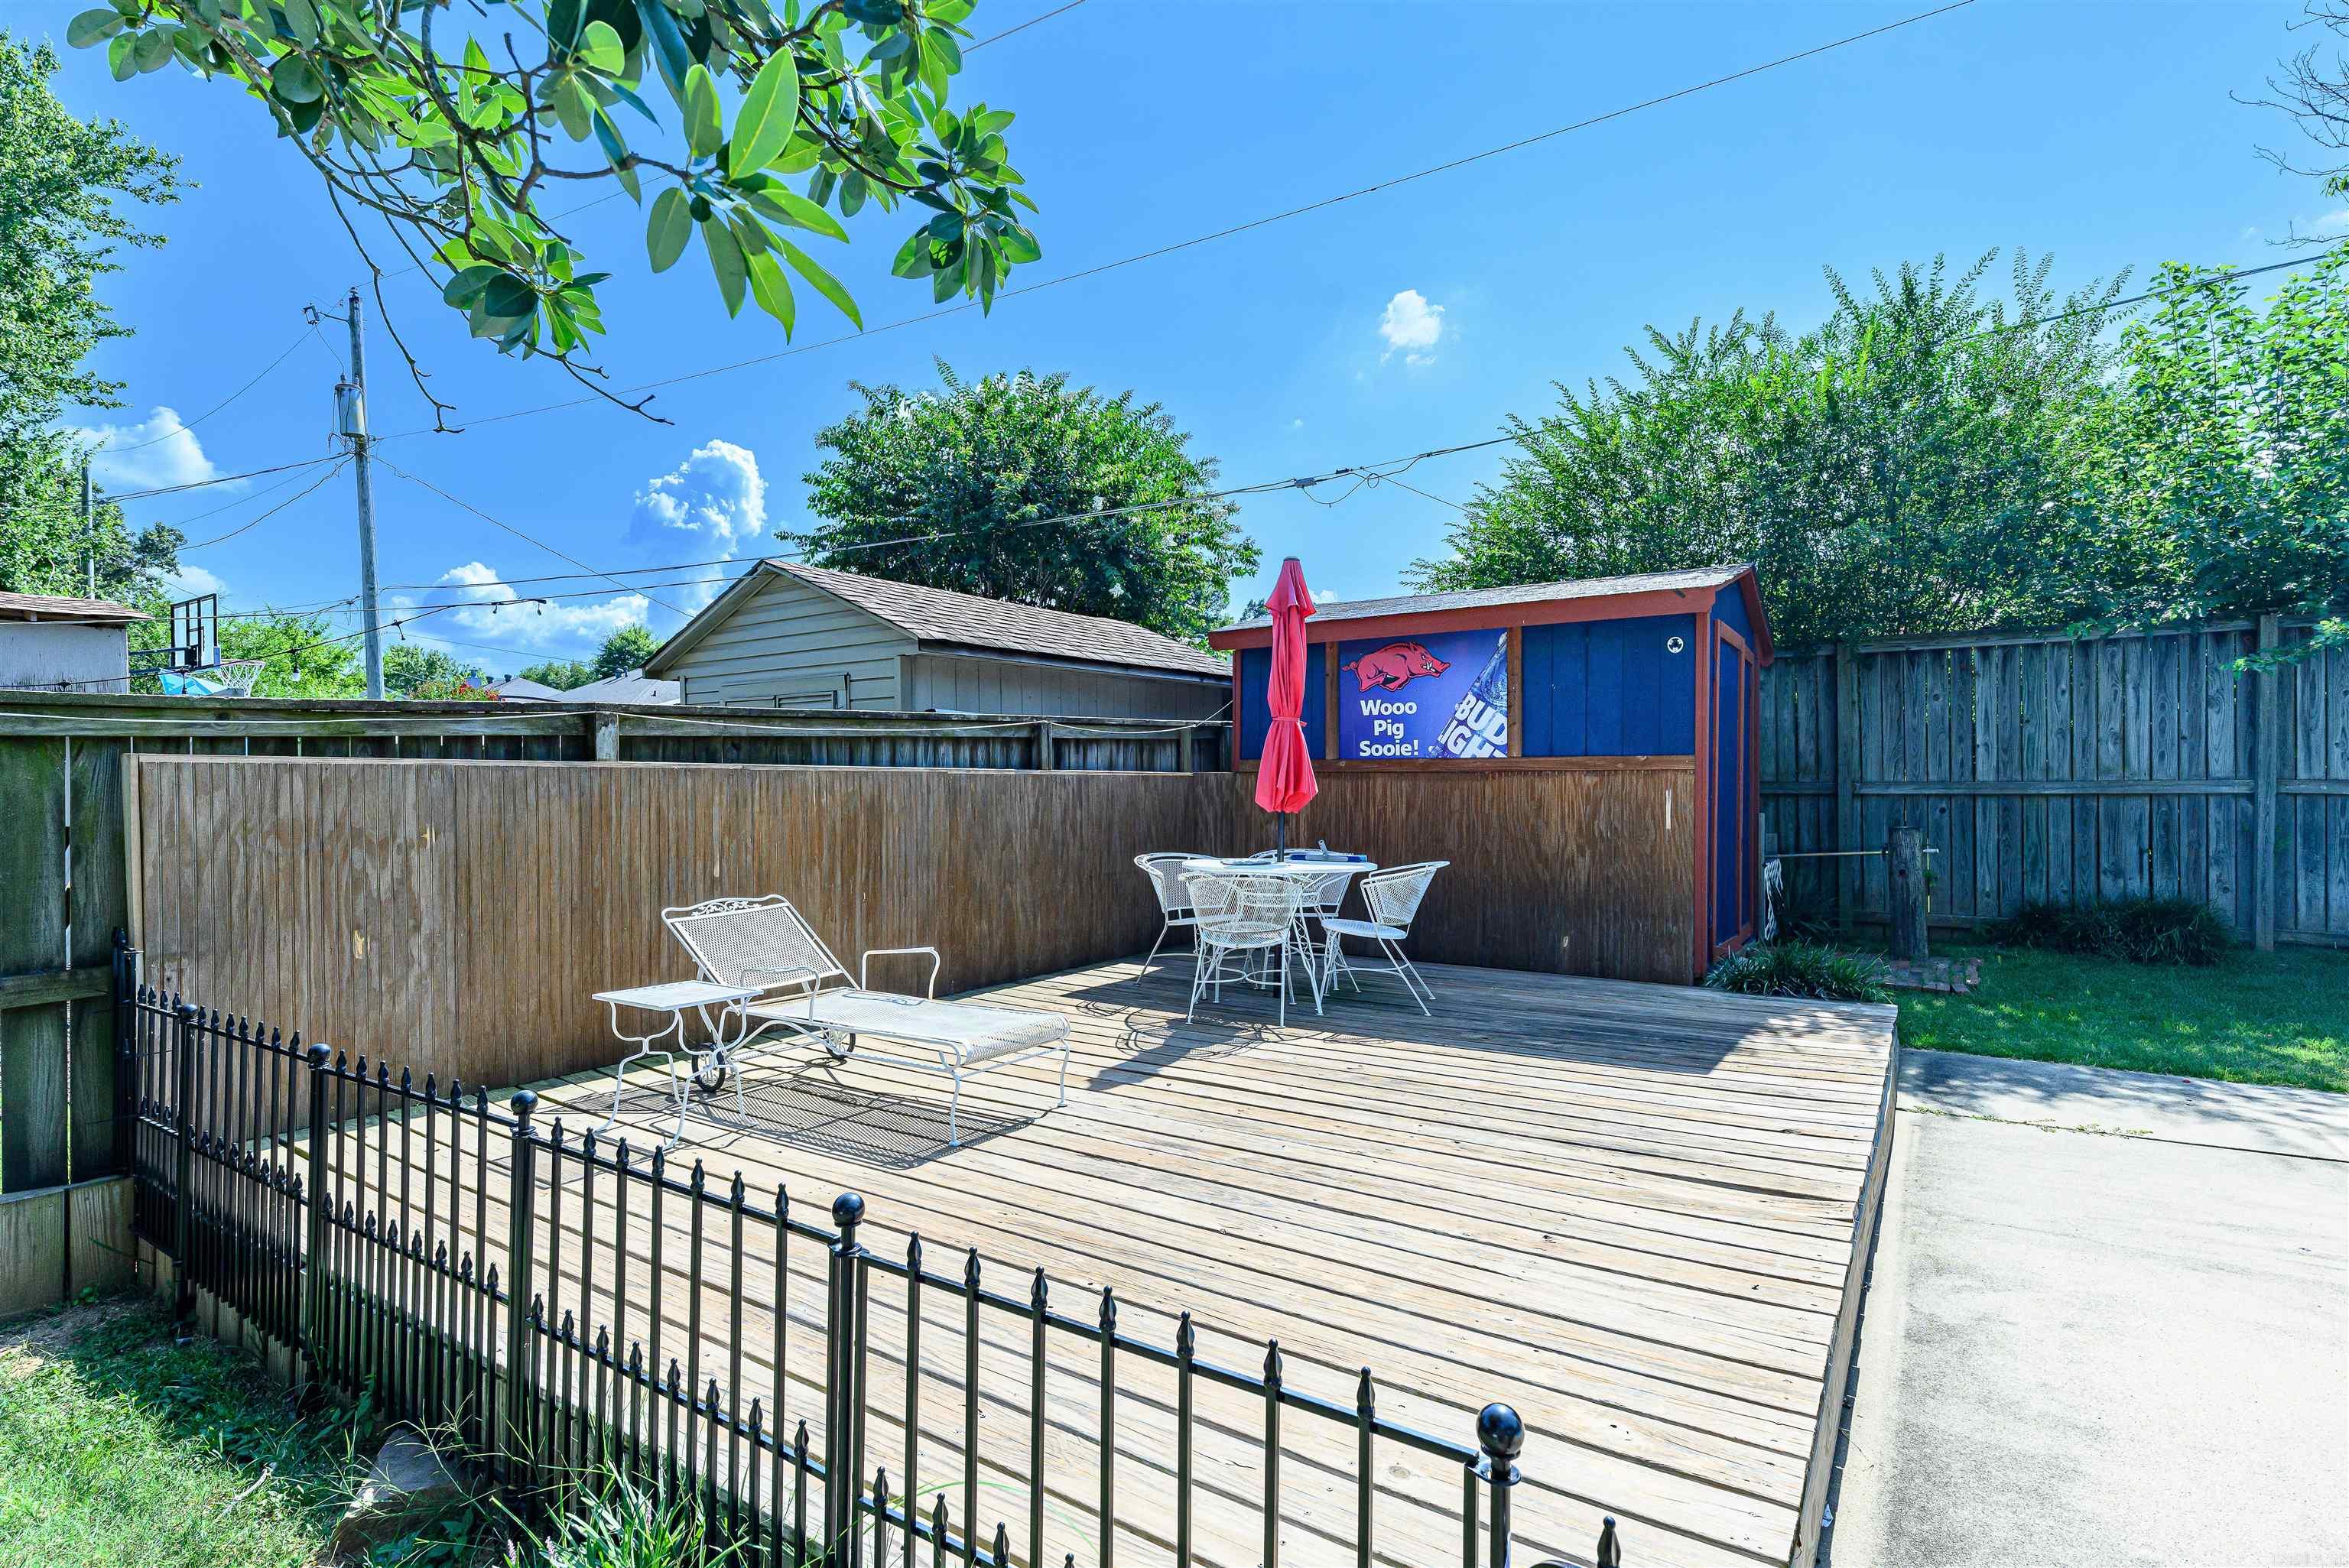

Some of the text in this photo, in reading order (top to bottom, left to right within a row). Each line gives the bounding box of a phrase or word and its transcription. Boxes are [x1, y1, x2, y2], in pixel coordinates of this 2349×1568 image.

[1360, 700, 1417, 716] Wooo
[1454, 690, 1508, 745] BUD
[1373, 719, 1404, 740] Pig
[1359, 739, 1418, 757] Sooie!
